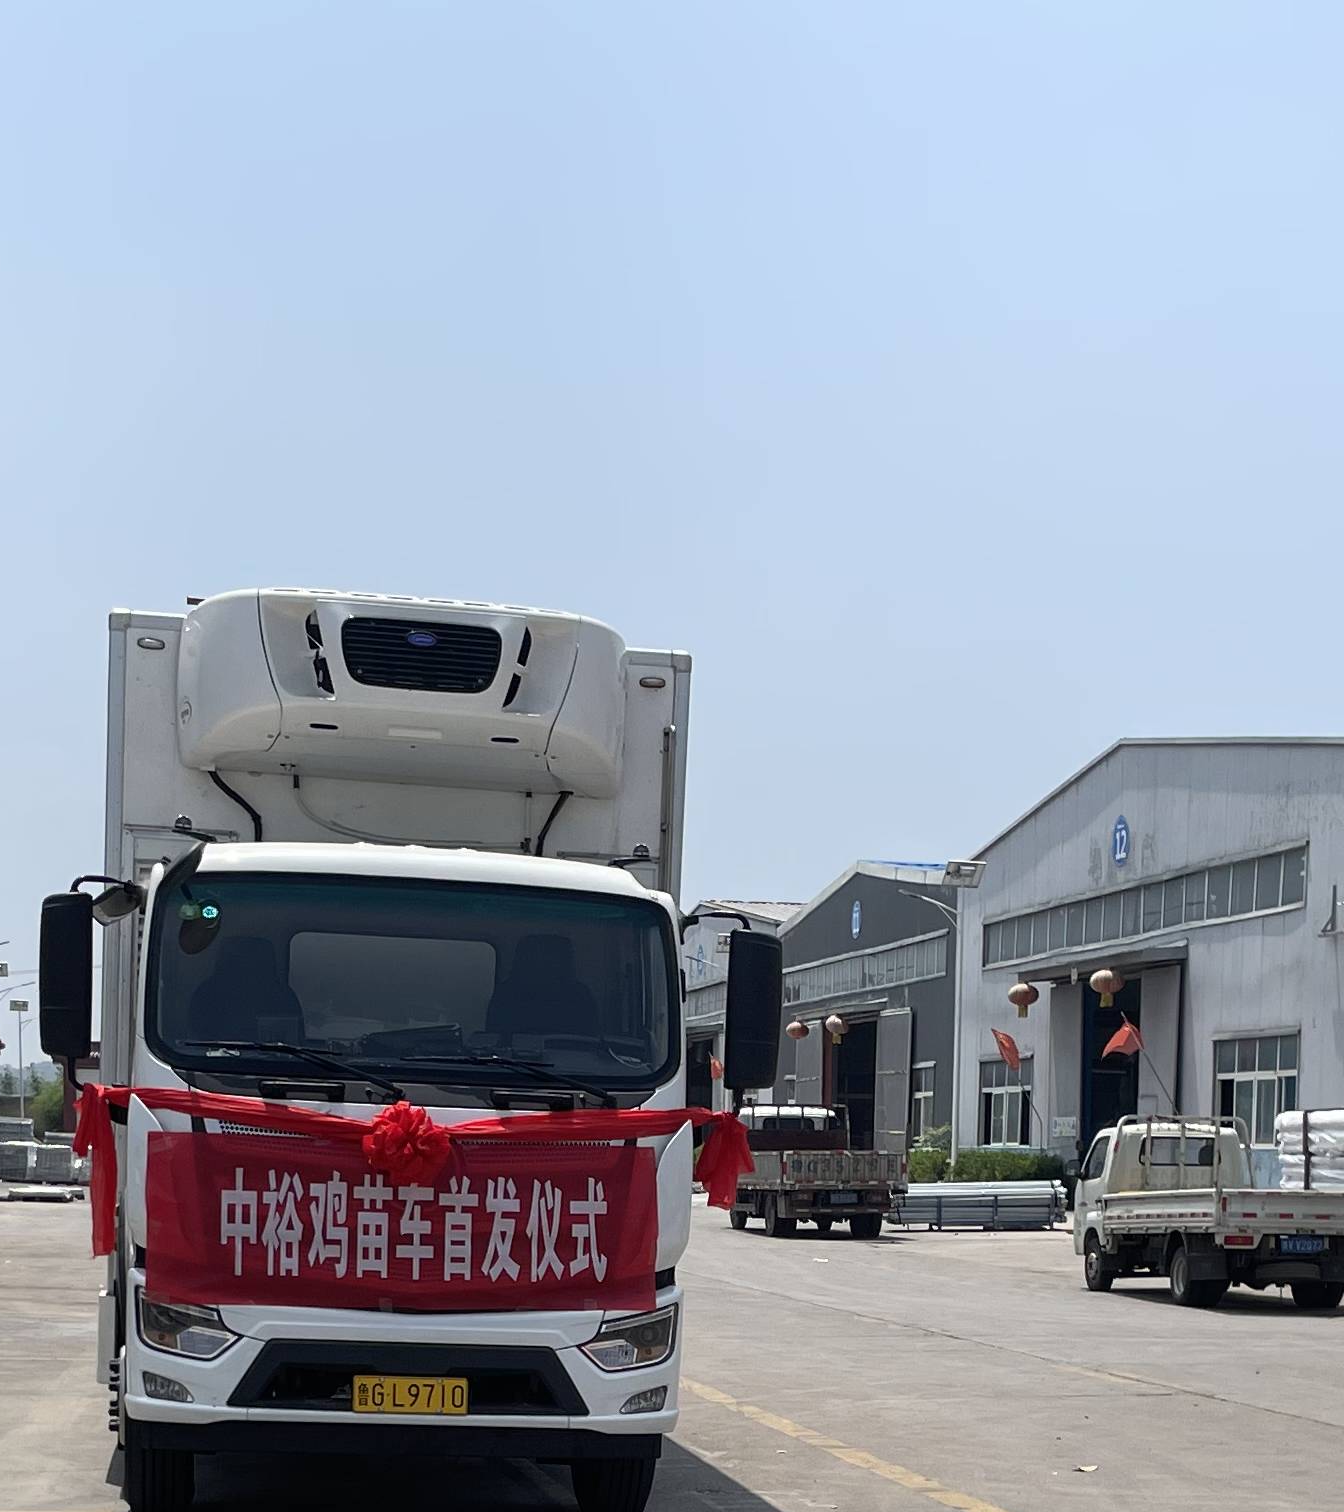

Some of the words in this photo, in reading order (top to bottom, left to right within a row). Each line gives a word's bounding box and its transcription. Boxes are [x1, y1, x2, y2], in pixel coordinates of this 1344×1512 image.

[1116, 829, 1127, 860] 12
[220, 1167, 608, 1283] 中裕鸡苗车首发仪式
